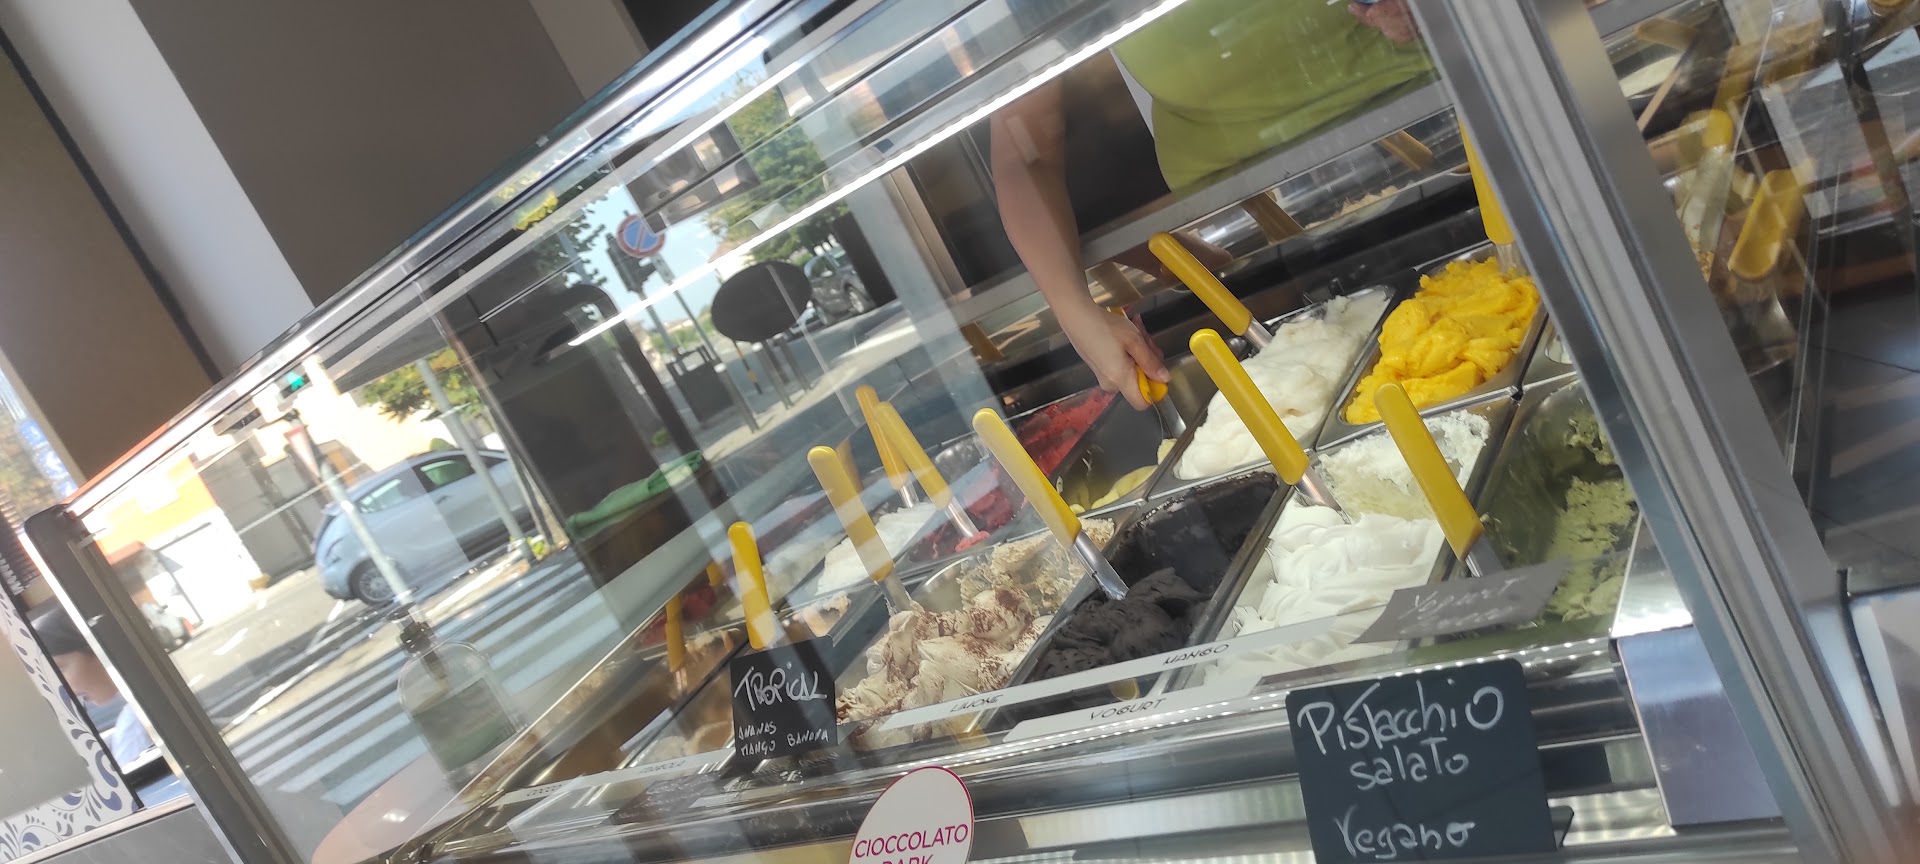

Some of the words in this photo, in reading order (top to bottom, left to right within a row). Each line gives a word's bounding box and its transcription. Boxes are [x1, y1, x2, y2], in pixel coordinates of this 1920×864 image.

[1089, 697, 1166, 721] YOGURT
[738, 720, 777, 740] ANANAS
[740, 740, 776, 756] MANGO
[786, 728, 829, 747] BANANA
[855, 823, 968, 858] CIOCCOLATO
[1333, 803, 1476, 859] Vegano
